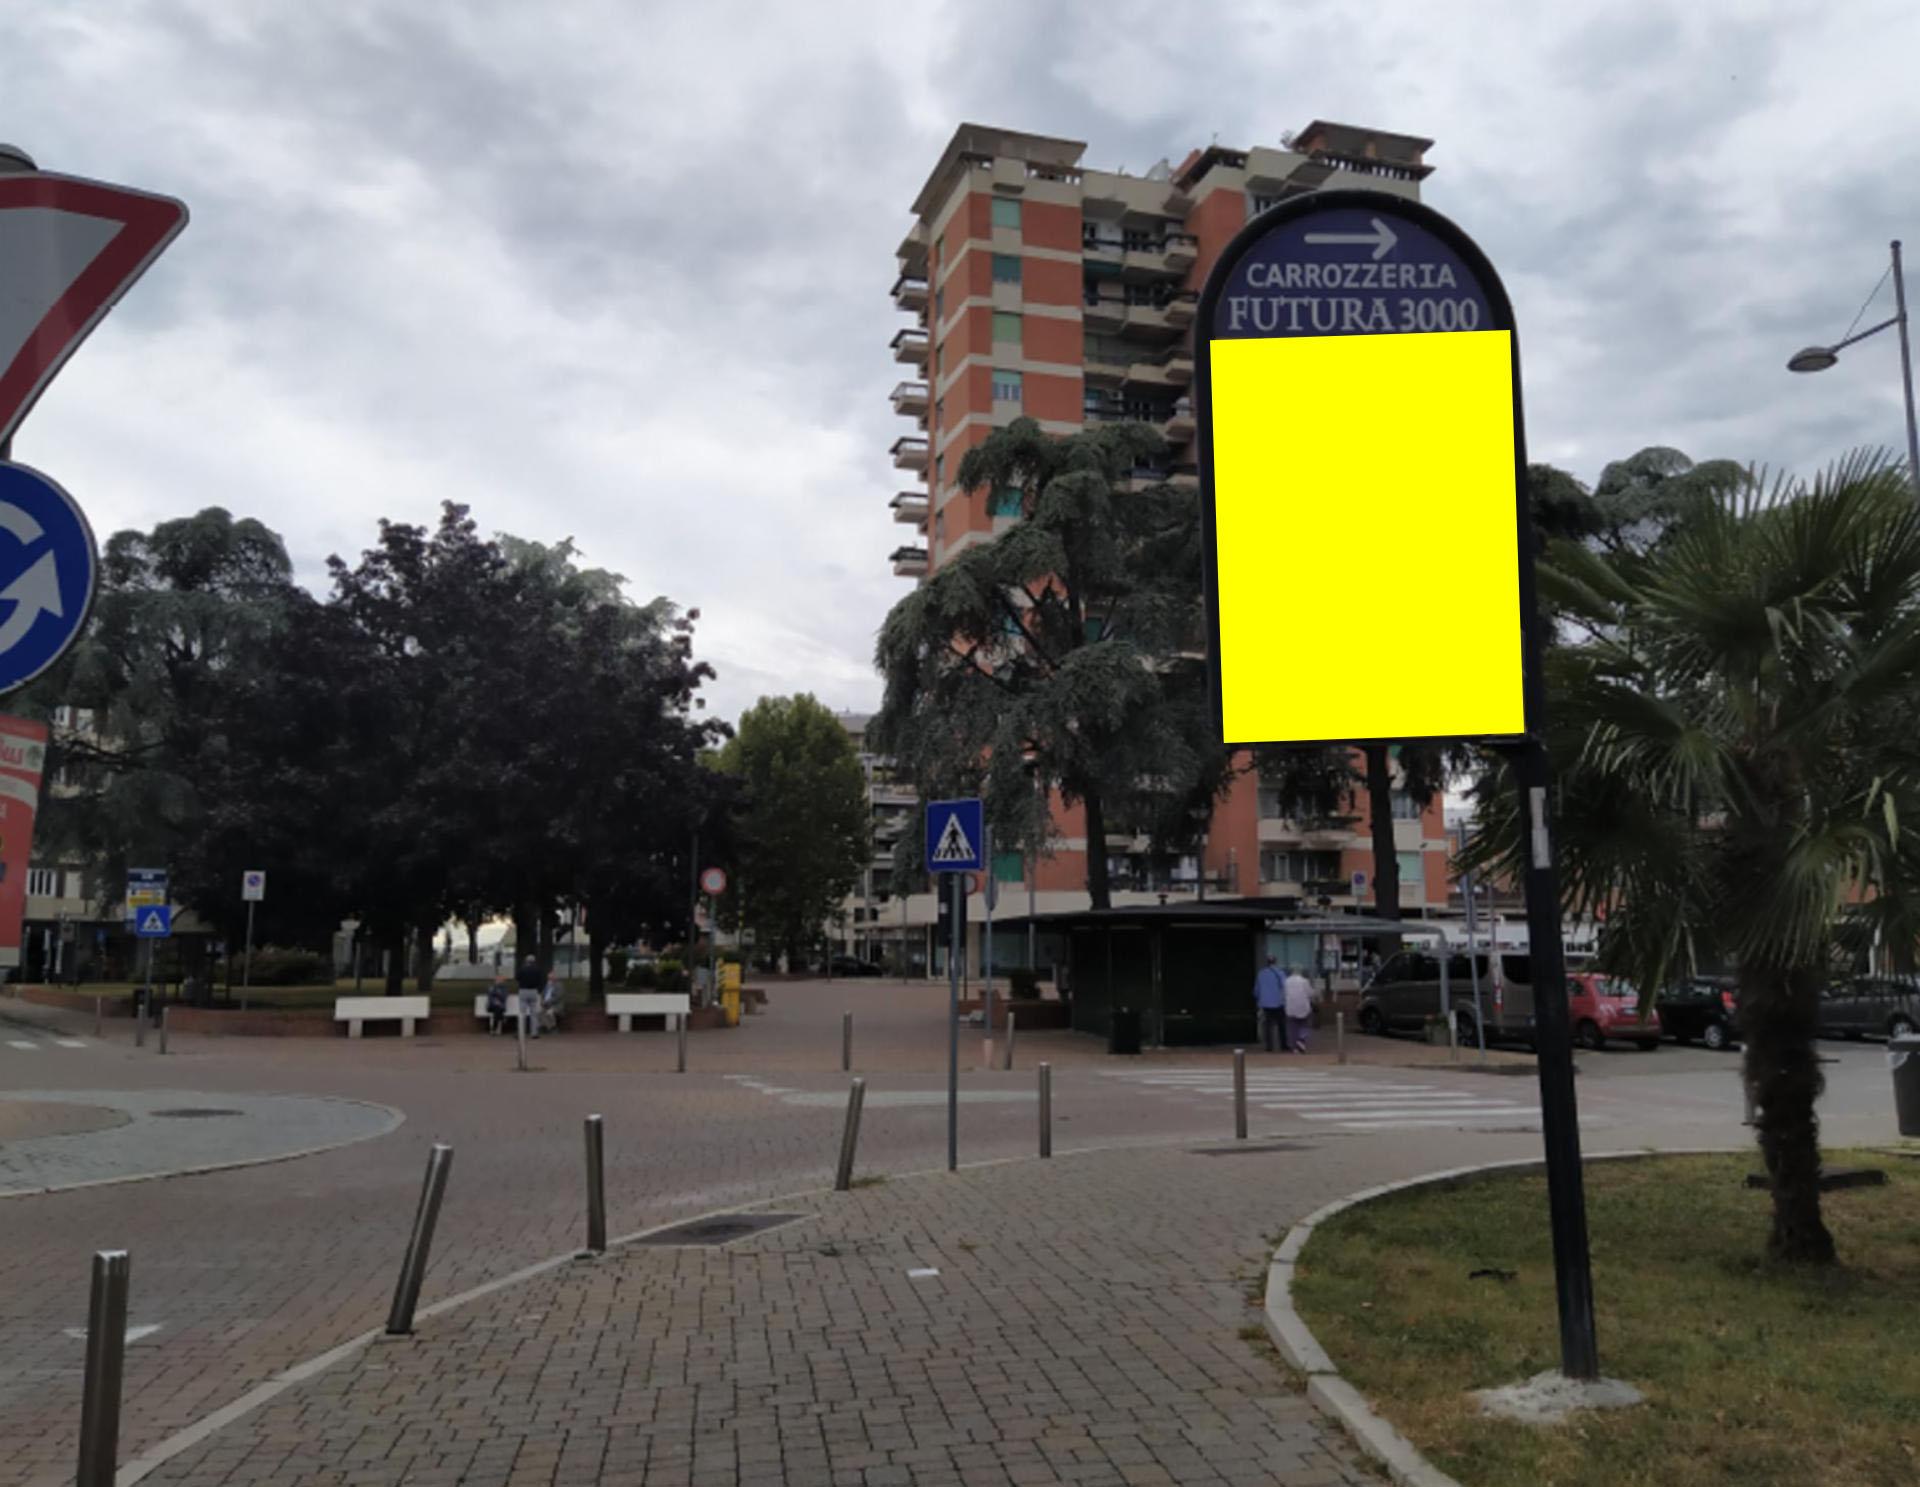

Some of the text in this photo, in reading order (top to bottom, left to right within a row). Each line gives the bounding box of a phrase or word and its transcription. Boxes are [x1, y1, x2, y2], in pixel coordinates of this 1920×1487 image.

[1247, 264, 1456, 288] CARROZZERIA
[1228, 296, 1479, 332] FUTURA 3000
